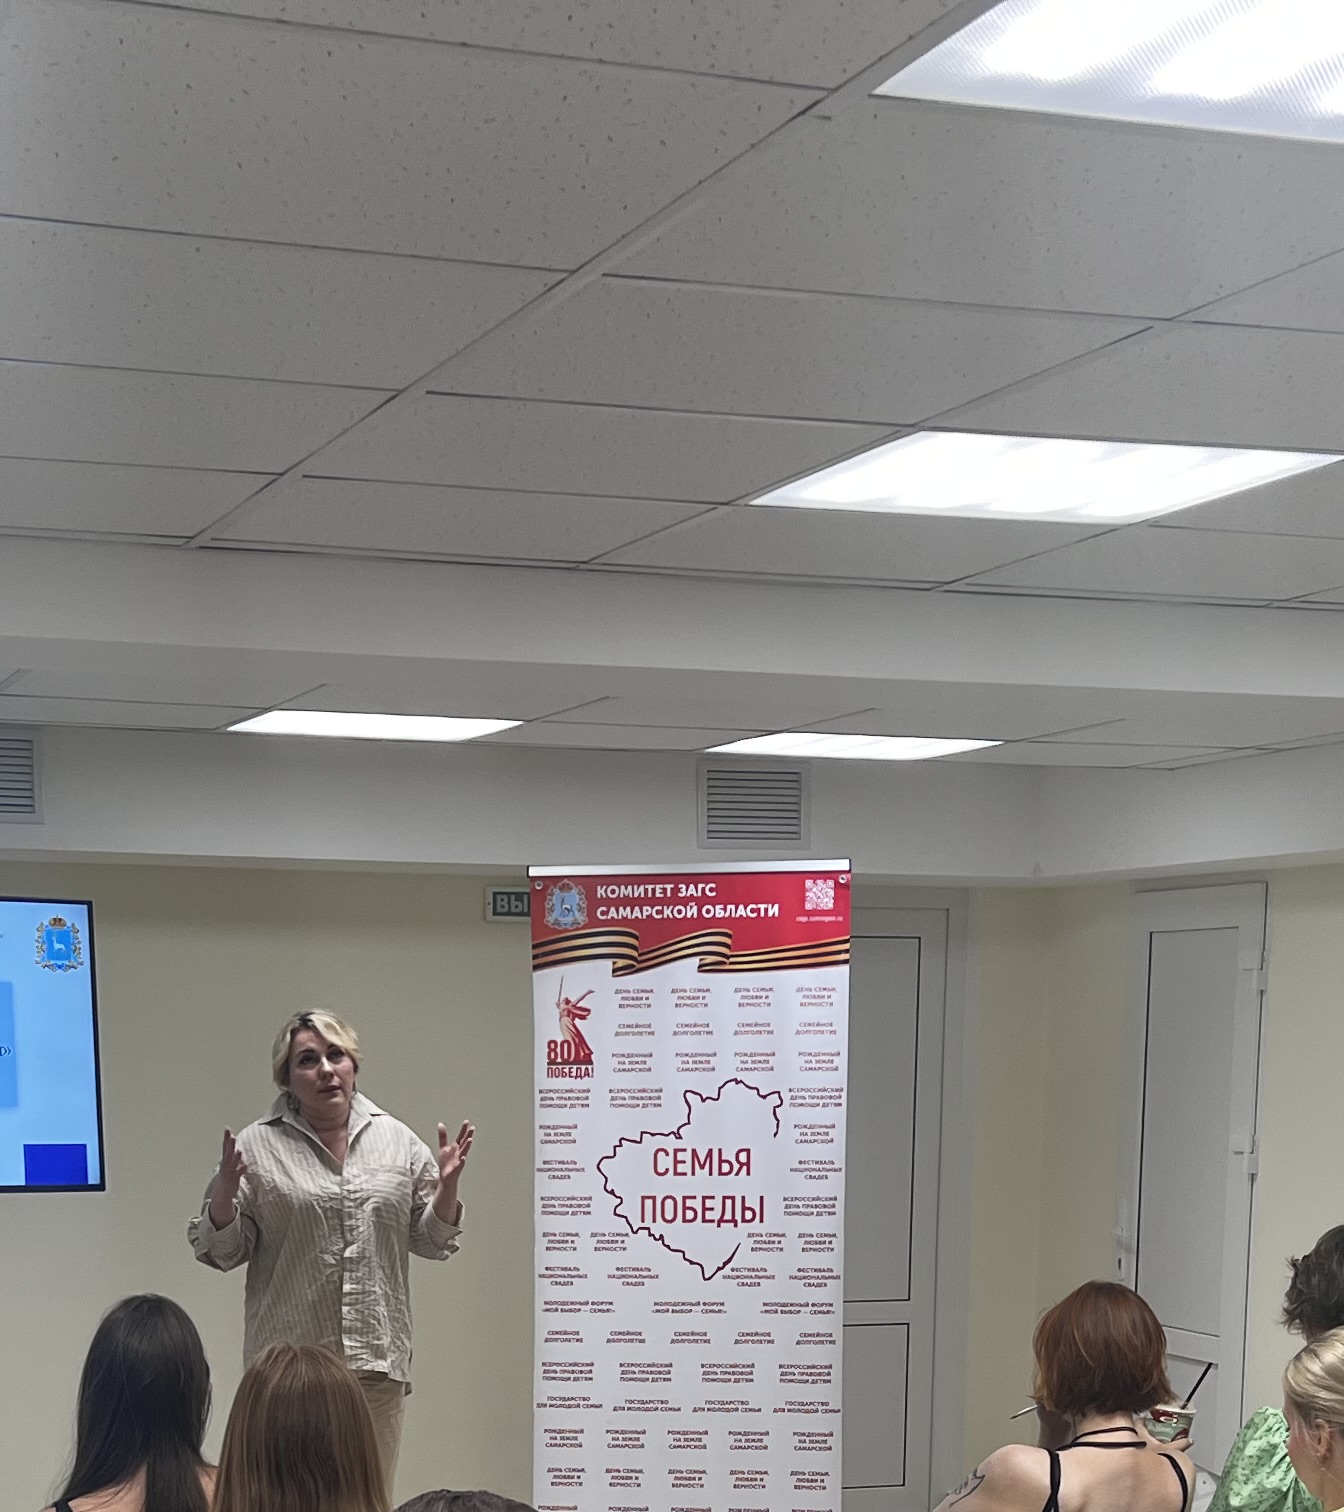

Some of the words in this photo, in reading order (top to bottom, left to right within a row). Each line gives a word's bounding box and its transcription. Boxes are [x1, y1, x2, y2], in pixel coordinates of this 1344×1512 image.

[597, 884, 674, 899] КОМИТЕТ
[677, 883, 717, 898] ЗАГС
[596, 902, 698, 919] САМАРСКОЙ
[702, 903, 779, 918] ОБЛАСТИ
[547, 1039, 571, 1062] 80
[547, 1066, 594, 1080] ПОБЕДА!
[653, 1148, 751, 1177] СЕМЬЯ
[640, 1195, 765, 1229] ПОБЕДЫ
